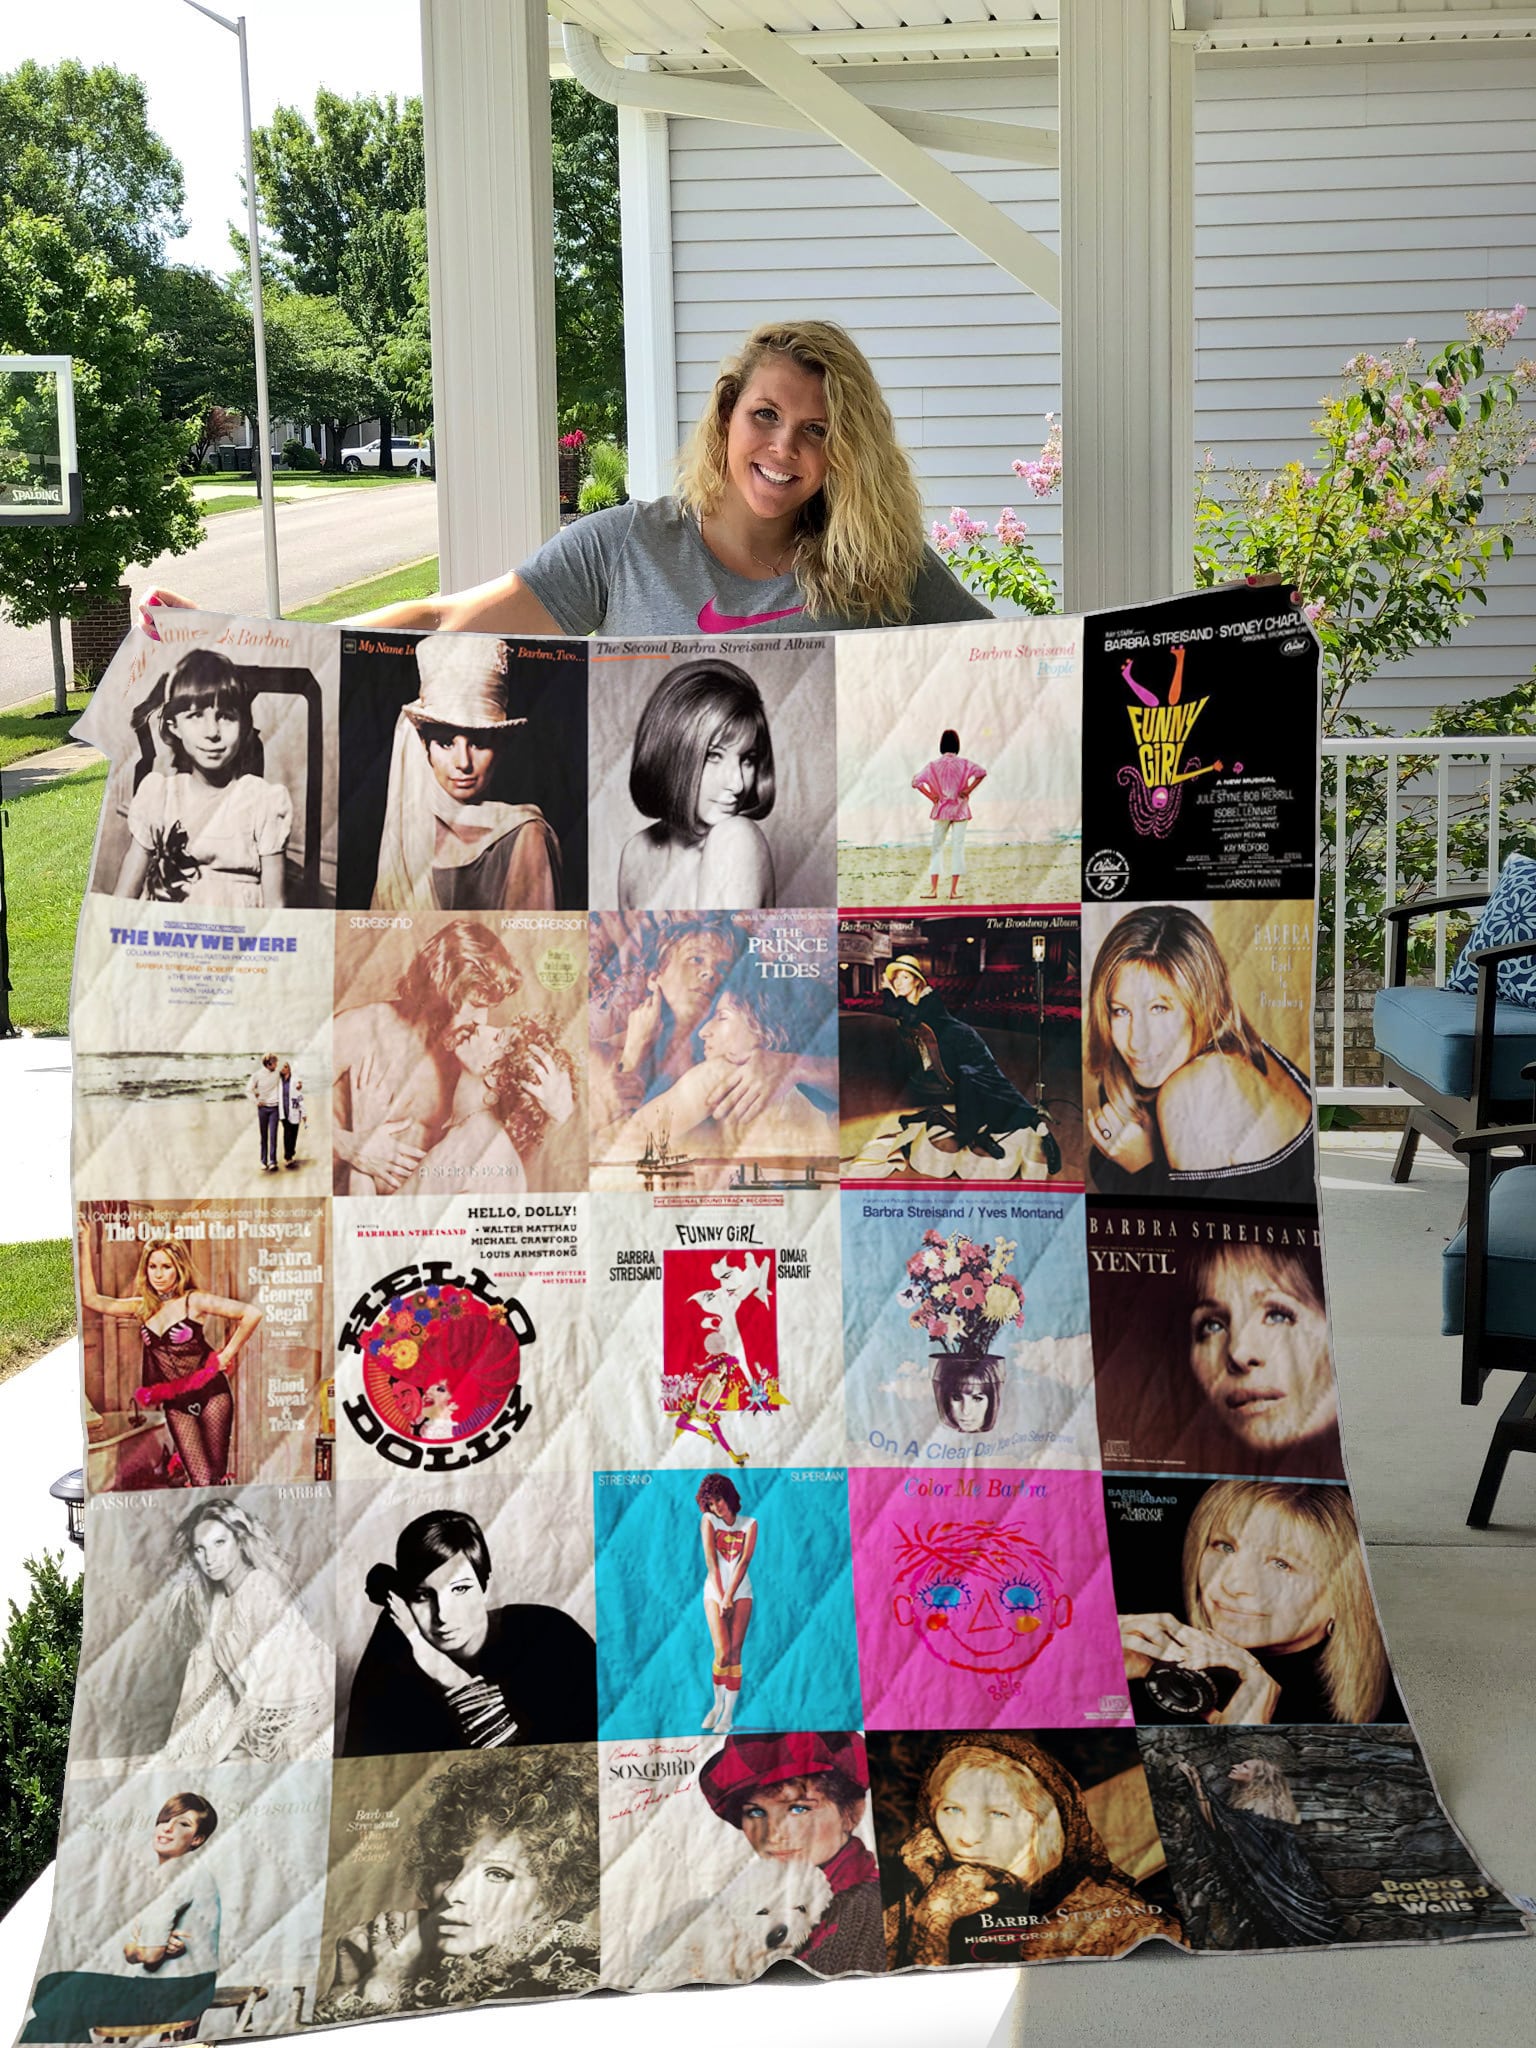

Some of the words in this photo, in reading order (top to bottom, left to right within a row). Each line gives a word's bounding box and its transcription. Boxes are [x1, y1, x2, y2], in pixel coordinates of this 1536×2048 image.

[12, 489, 60, 501] SPALDING
[217, 628, 233, 645] Is
[238, 629, 290, 649] Barbra
[1104, 635, 1150, 652] BARBRA
[1152, 627, 1213, 646] STREISAND
[1220, 618, 1263, 638] SYDNEY
[358, 640, 374, 653] My
[375, 642, 404, 655] Name
[405, 644, 415, 655] Is
[518, 646, 555, 660] Barbra,
[596, 643, 619, 655] The
[622, 641, 667, 655] Second
[671, 641, 715, 654] Barbra
[719, 640, 781, 654] Streisand
[784, 638, 826, 650] Album
[969, 646, 1012, 662] Barbra
[1015, 642, 1076, 658] Streisand
[1127, 696, 1210, 746] FUNNY
[1097, 876, 1118, 890] 75
[350, 917, 413, 929] STREISAND
[501, 918, 588, 931] KRISTOFFERSON
[840, 921, 871, 932] Barbra
[872, 920, 915, 931] Streisand
[986, 918, 1004, 929] The
[1005, 917, 1049, 930] Broadway
[1049, 917, 1079, 928] Album
[110, 927, 149, 946] THE
[153, 931, 198, 948] WAY
[201, 934, 234, 951] WE
[238, 936, 297, 953] WERE
[772, 927, 804, 938] THE
[1254, 923, 1311, 945] BARBRA
[747, 936, 829, 954] PRINCE
[778, 953, 798, 963] OF
[754, 961, 820, 979] TIDES
[468, 1207, 521, 1219] HELLO,
[525, 1205, 577, 1217] DOLLY!
[863, 1206, 903, 1217] Barbra
[907, 1206, 965, 1218] Streisand
[978, 1207, 1007, 1218] Yves
[1011, 1207, 1064, 1219] Montand
[105, 1222, 136, 1241] The
[138, 1220, 171, 1241] Owl
[174, 1220, 205, 1240] and
[208, 1220, 236, 1239] the
[237, 1220, 311, 1242] Pussycat
[482, 1226, 523, 1234] WALTER
[526, 1224, 577, 1233] MATTHAU
[675, 1224, 723, 1245] FUNNY
[1090, 1217, 1178, 1237] BARBRA
[1192, 1221, 1321, 1247] STREISAND
[471, 1236, 518, 1246] MICHAEL
[521, 1235, 578, 1245] CRAWFORD
[258, 1248, 312, 1266] Barbra
[480, 1250, 511, 1259] LOUIS
[513, 1248, 578, 1258] ARMSTRONG
[617, 1250, 655, 1264] BARBRA
[780, 1249, 808, 1264] OMAR
[1090, 1251, 1176, 1274] YENTL
[248, 1265, 323, 1285] Streisand
[610, 1266, 662, 1281] STREISAND
[778, 1265, 811, 1279] SHARIF
[259, 1286, 313, 1305] George
[265, 1304, 308, 1325] Segal
[337, 1261, 536, 1354] HELLO
[268, 1377, 308, 1394] Blood,
[267, 1392, 306, 1408] Sweat
[281, 1406, 292, 1420] &
[268, 1417, 305, 1432] Tears
[342, 1384, 533, 1472] DOLLY
[869, 1430, 899, 1453] On
[904, 1440, 920, 1458] A
[926, 1442, 972, 1460] Clear
[598, 1475, 652, 1486] STREISAND
[790, 1471, 844, 1482] SUPERMAN
[278, 1484, 332, 1500] BARBRA
[904, 1478, 952, 1498] Color
[955, 1478, 982, 1497] Me
[988, 1478, 1047, 1498] Barbra
[1107, 1489, 1151, 1497] BARBRA
[1111, 1501, 1131, 1509] THE
[609, 1757, 695, 1782] SONGBIRD
[1380, 1878, 1466, 1893] Barbra
[1370, 1886, 1490, 1905] Streisand
[1400, 1900, 1475, 1915] Walls
[964, 1933, 1017, 1944] HIGHER
